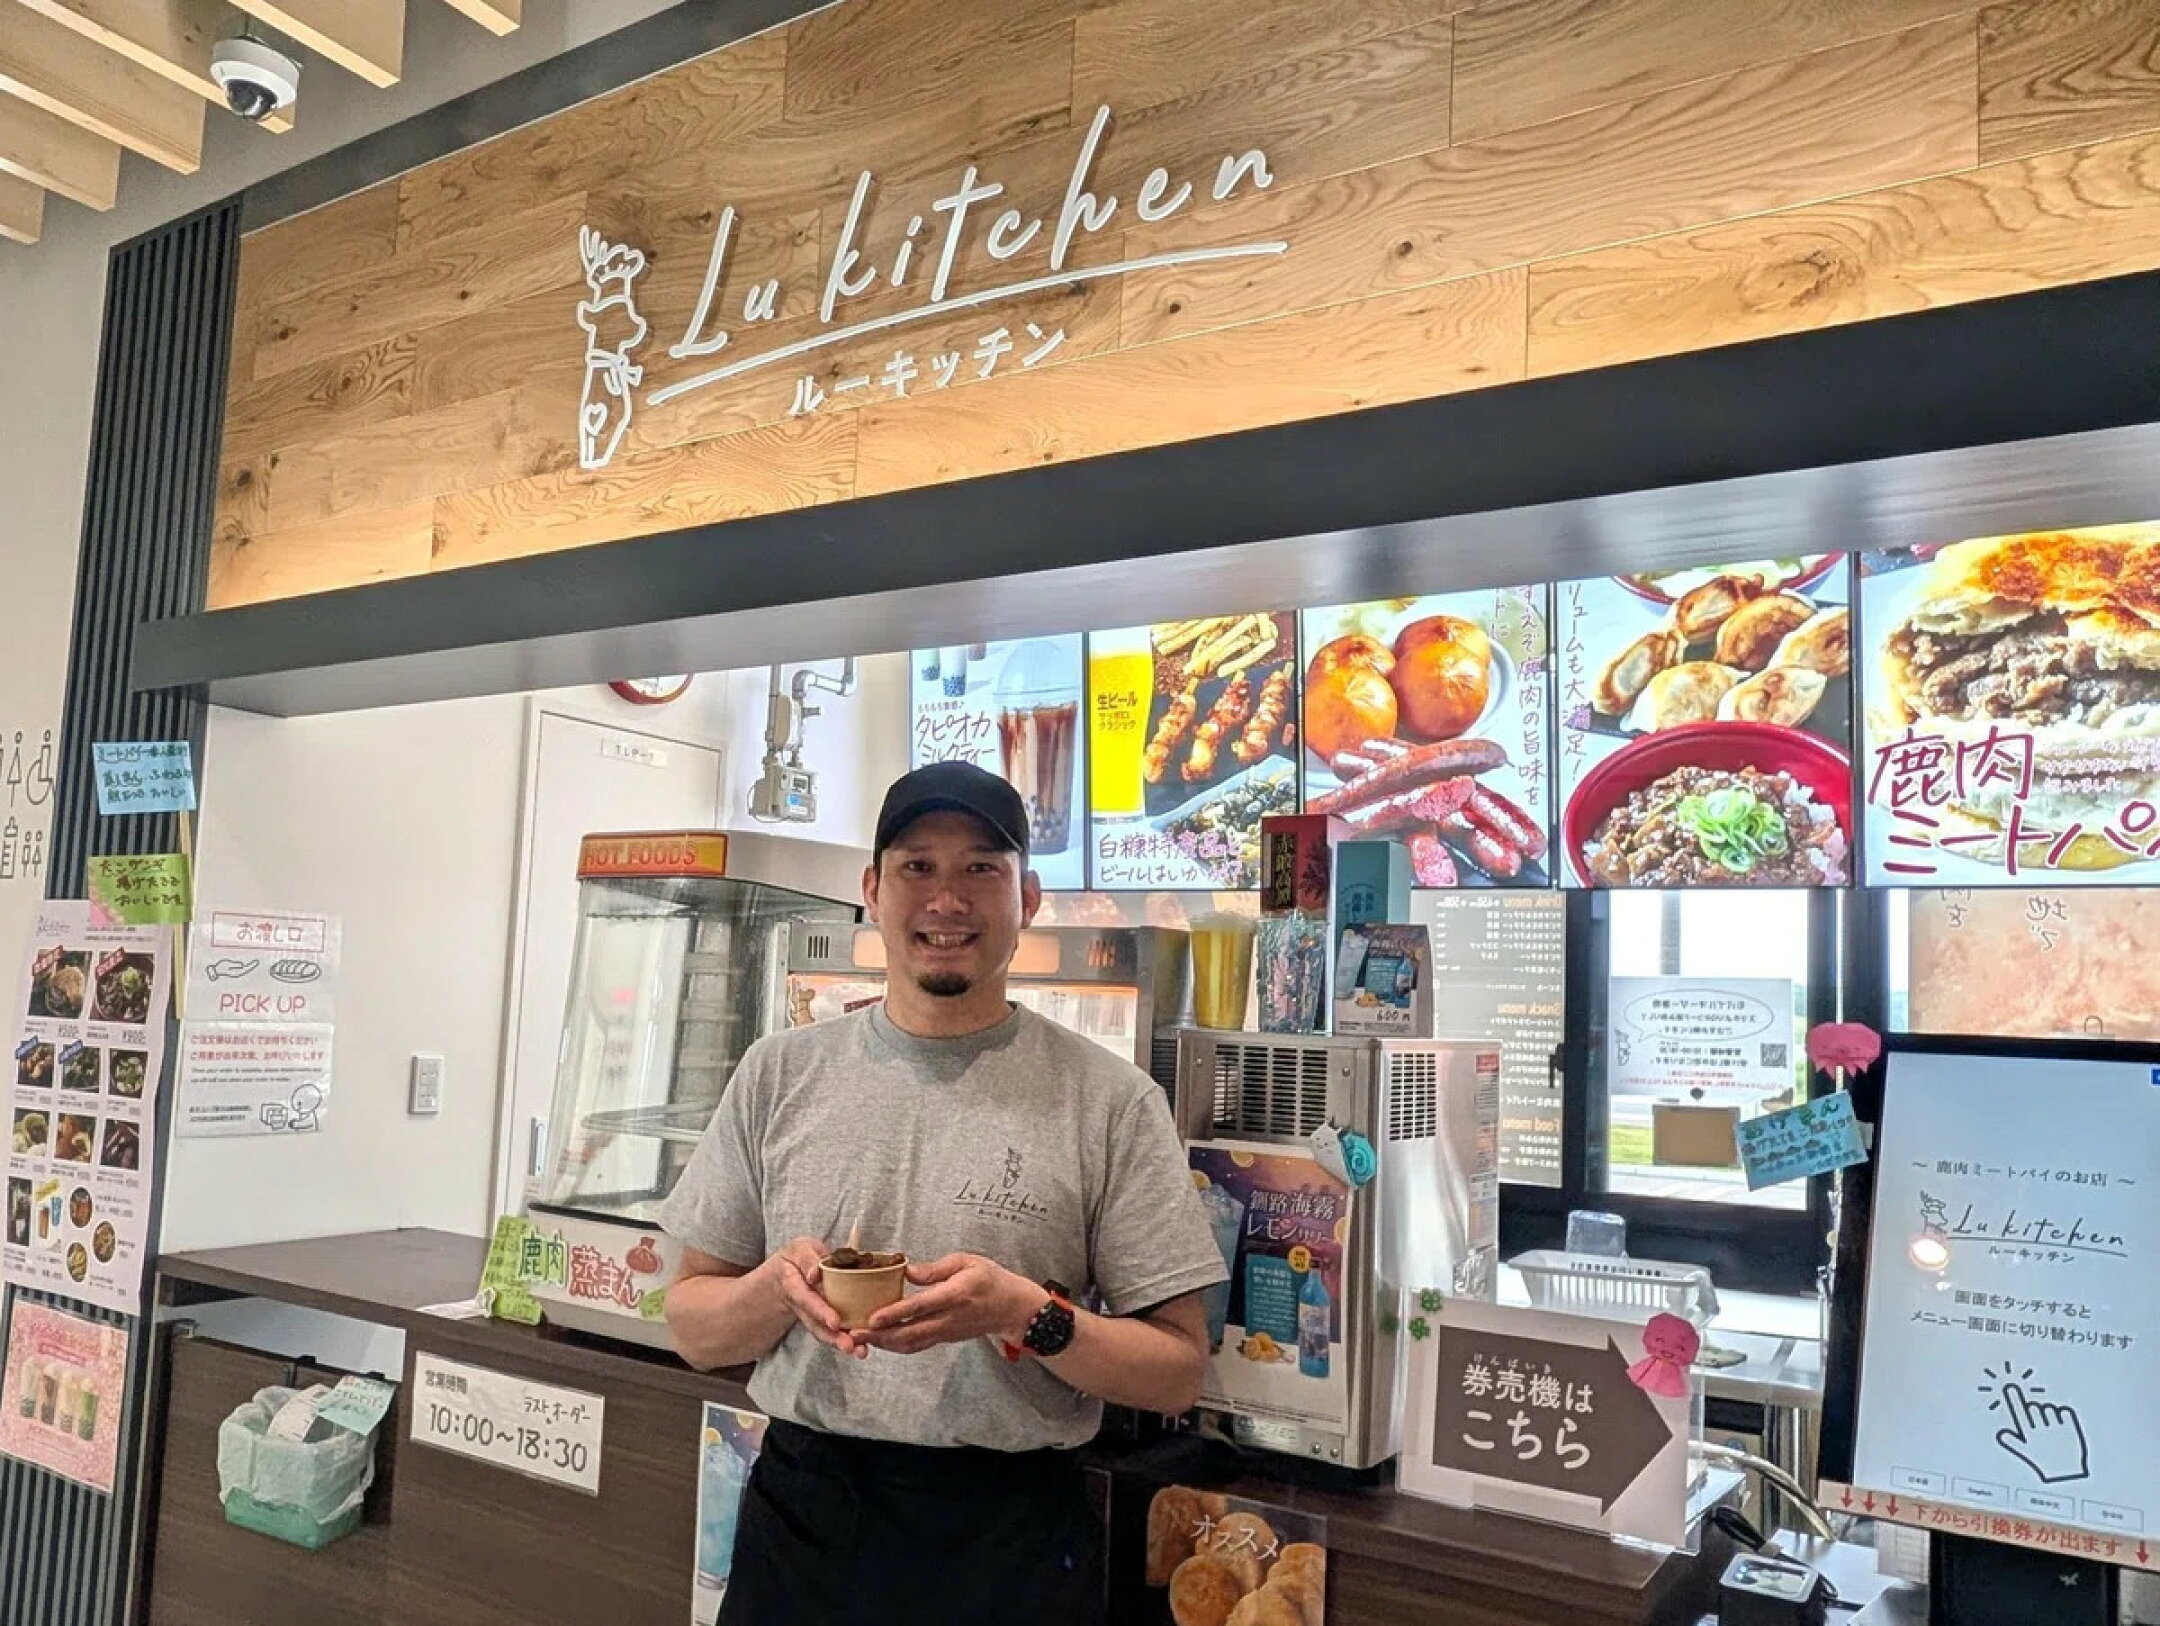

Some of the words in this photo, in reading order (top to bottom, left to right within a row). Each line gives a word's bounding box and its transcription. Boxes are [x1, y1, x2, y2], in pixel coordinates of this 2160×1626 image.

[670, 206, 780, 359] Lu
[819, 104, 1273, 323] kitchen
[788, 321, 1067, 417] ルーキッチン
[915, 710, 991, 748] タピオカ
[1867, 726, 2034, 807] 鹿肉
[584, 842, 620, 865] HOT
[627, 841, 697, 865] FOODS
[1882, 800, 2160, 876] ミートパ
[237, 921, 303, 943] お渡し口
[219, 993, 271, 1013] PICK
[276, 995, 307, 1014] UP
[955, 1179, 977, 1200] Lu
[1952, 1203, 1989, 1234] Lu
[2000, 1208, 2124, 1247] kitchen
[1988, 1245, 2075, 1263] ルーキッチン
[1953, 1289, 2093, 1320] 画面をタッチすると
[1910, 1309, 2134, 1350] メニュー画面に切り替わります
[1462, 1362, 1594, 1414] 券売機は
[1462, 1409, 1592, 1471] こちら
[1189, 1513, 1279, 1561] オススメ
[1914, 1502, 2123, 1557] 下から引換券が出ます
